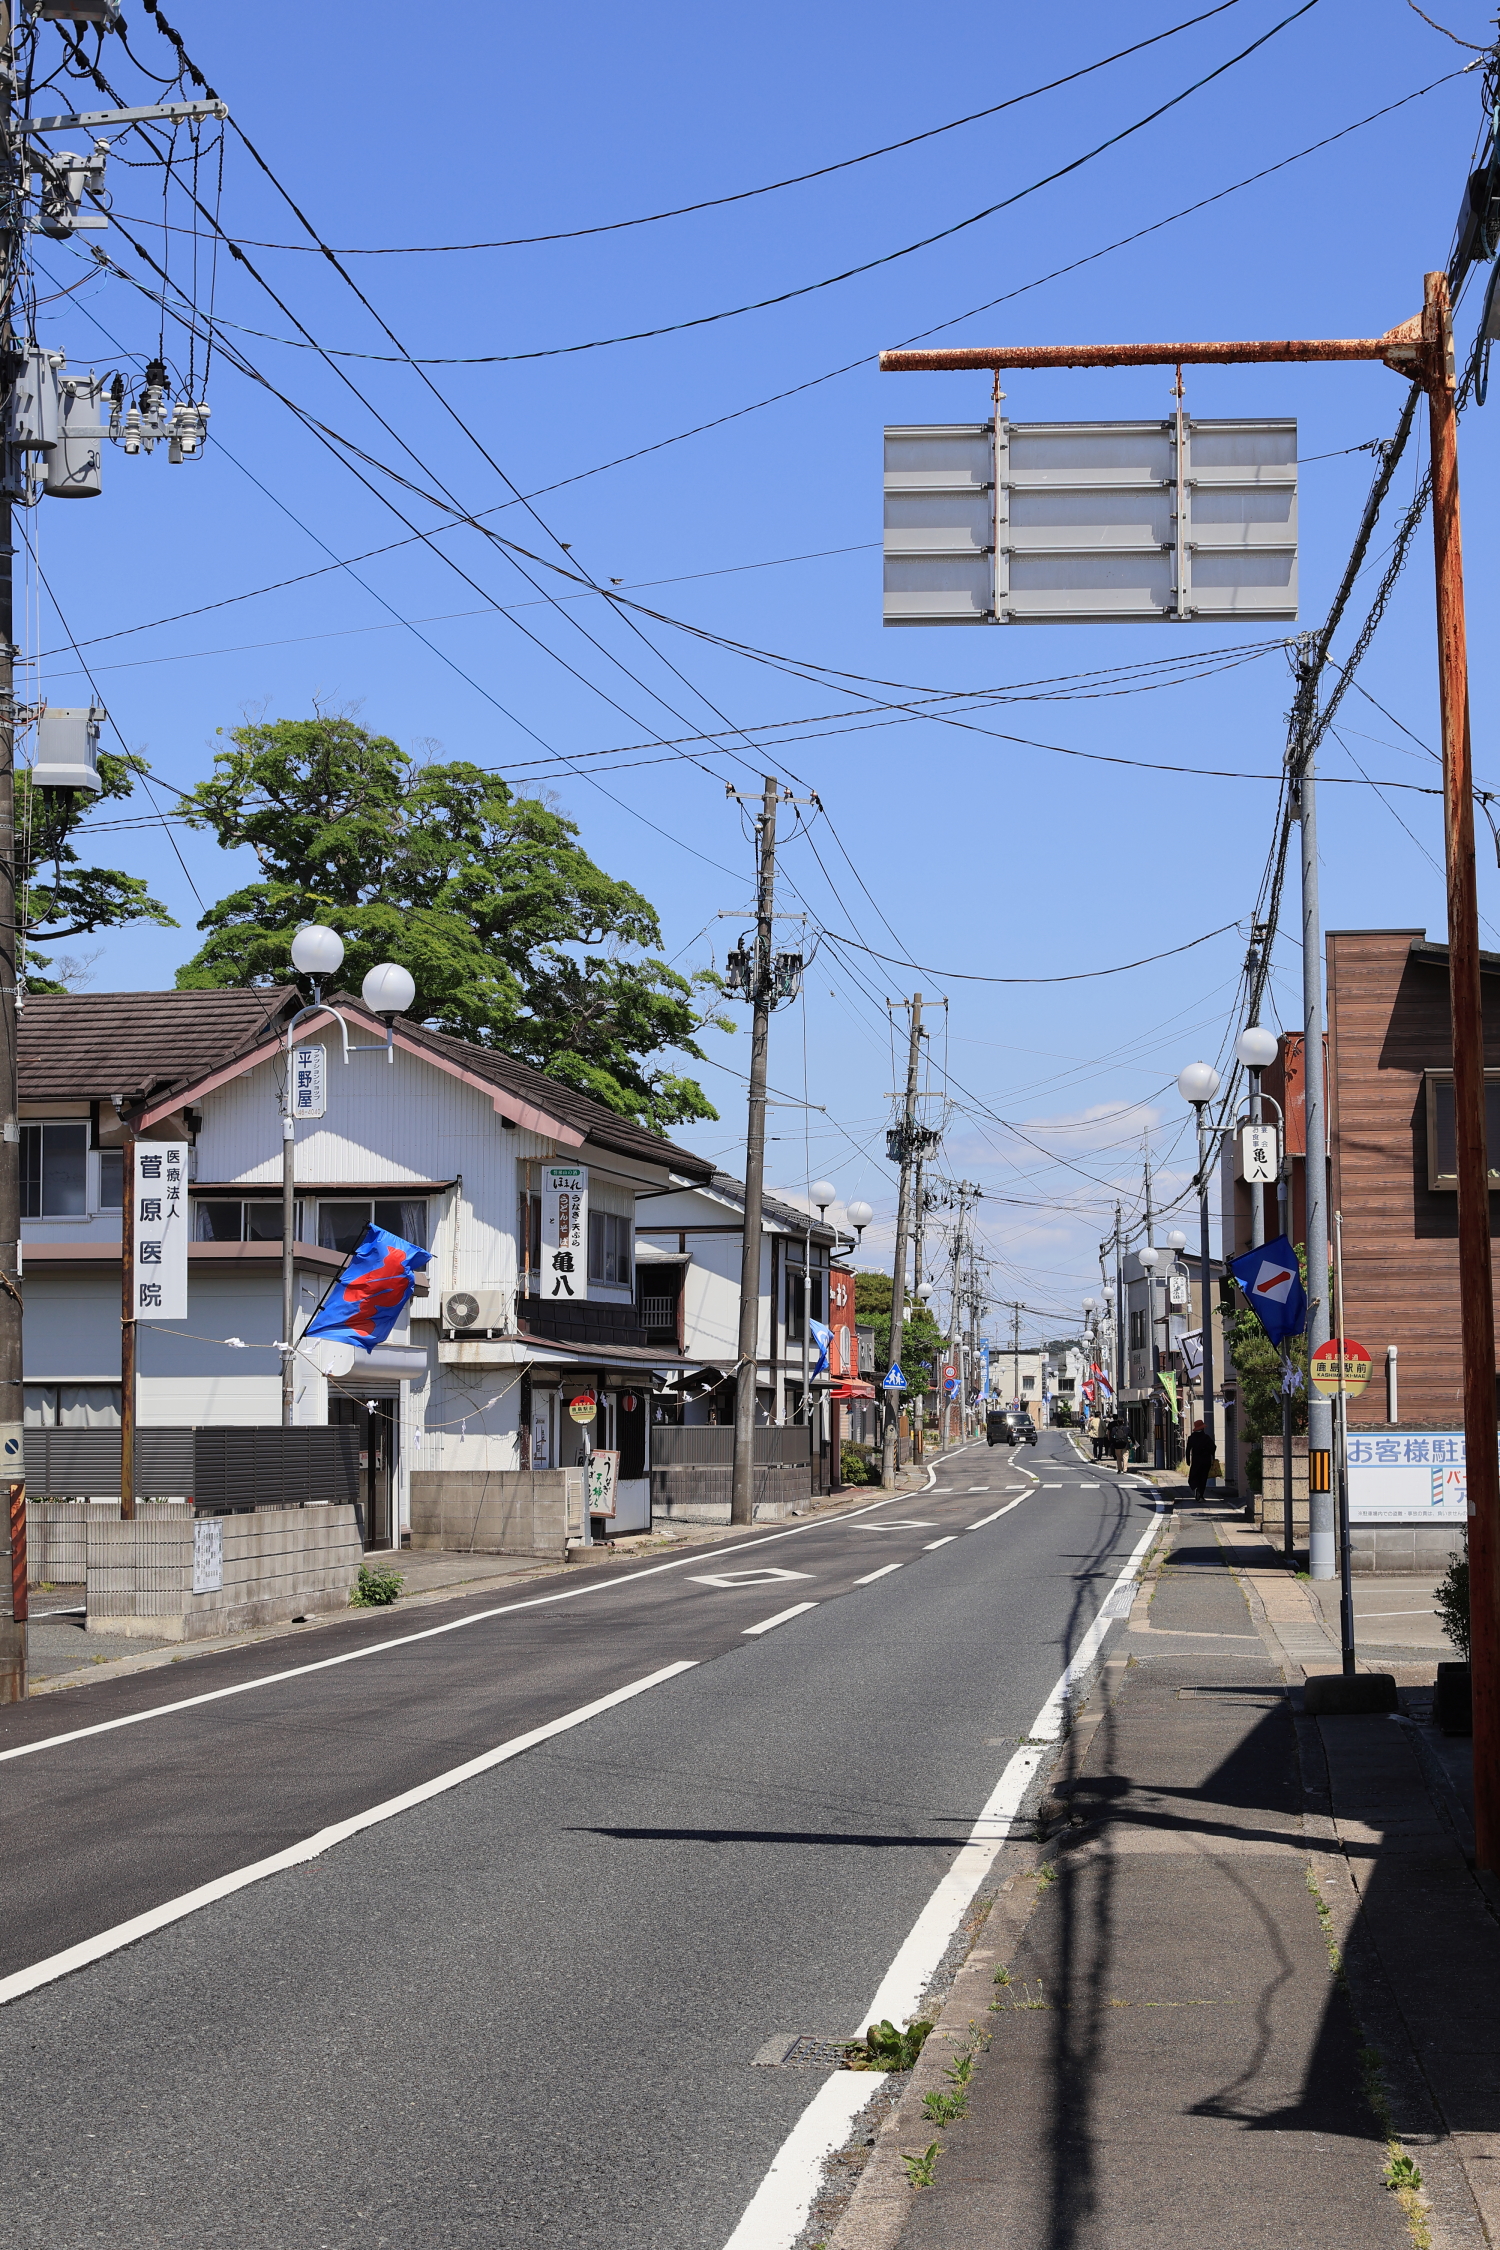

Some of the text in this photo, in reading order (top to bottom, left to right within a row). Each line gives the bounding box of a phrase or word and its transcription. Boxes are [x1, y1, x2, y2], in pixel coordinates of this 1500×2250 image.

[87, 449, 100, 470] 30
[297, 1051, 312, 1108] 平野屋
[1251, 1126, 1260, 1148] お食事
[1252, 1147, 1269, 1179] 亀八
[166, 1149, 181, 1219] 医療法人
[553, 1176, 582, 1190] ほまれ
[139, 1154, 163, 1308] 菅原医院
[559, 1194, 569, 1246] うどん・そば
[551, 1250, 575, 1297] 亀八
[1316, 1361, 1367, 1374] 鹿島駅前
